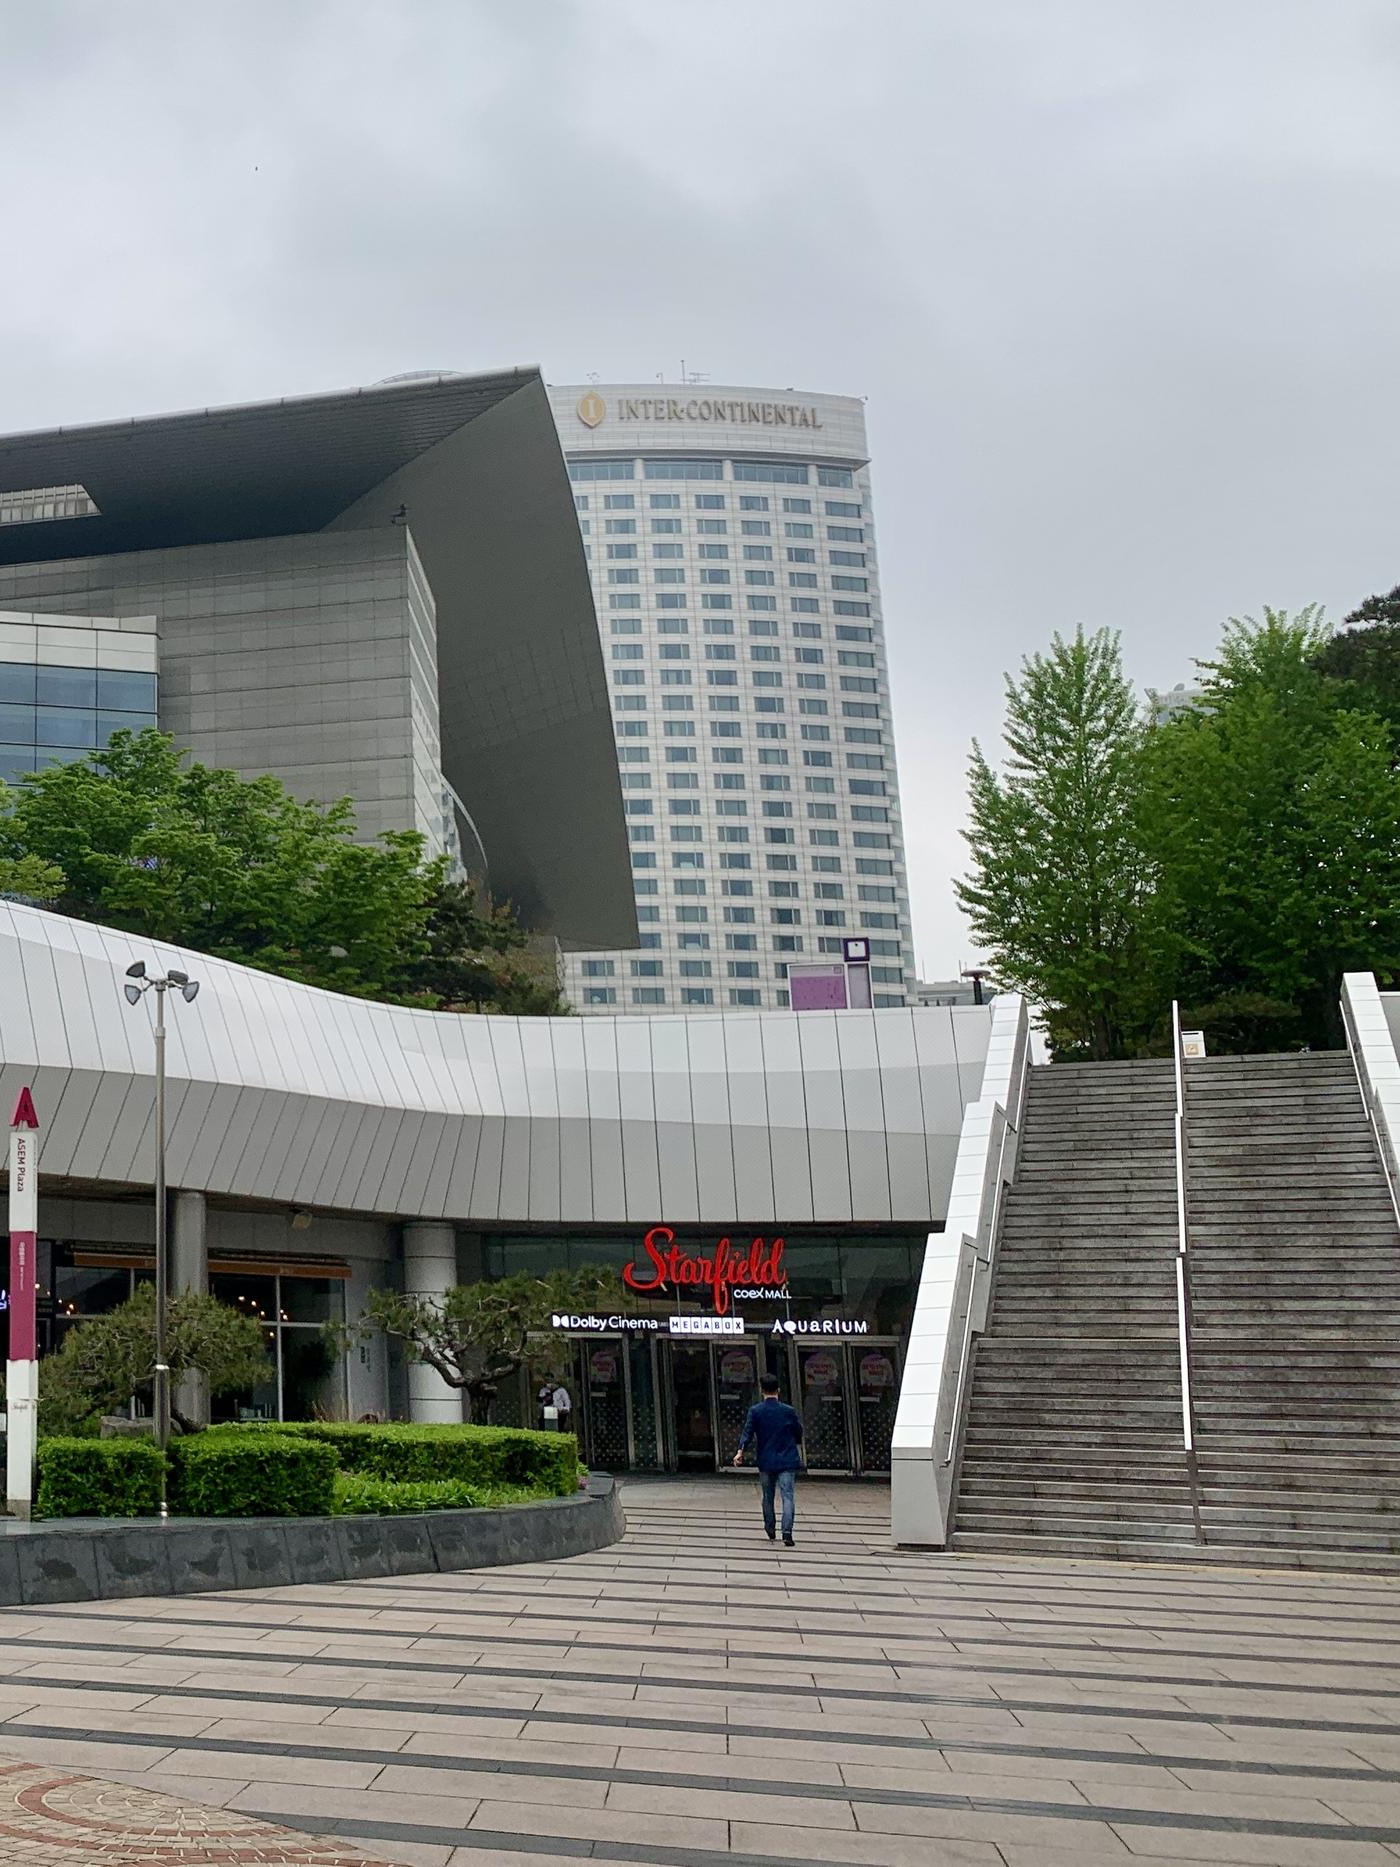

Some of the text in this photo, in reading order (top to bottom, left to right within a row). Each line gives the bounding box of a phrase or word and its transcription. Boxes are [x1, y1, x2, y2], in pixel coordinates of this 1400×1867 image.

[9, 1087, 39, 1128] A
[17, 1138, 26, 1192] ASEM Plaza
[623, 1227, 787, 1315] Starfield
[765, 1290, 792, 1300] MALL
[570, 1315, 658, 1332] Dolby Cinema
[671, 1320, 744, 1332] MEGABOX
